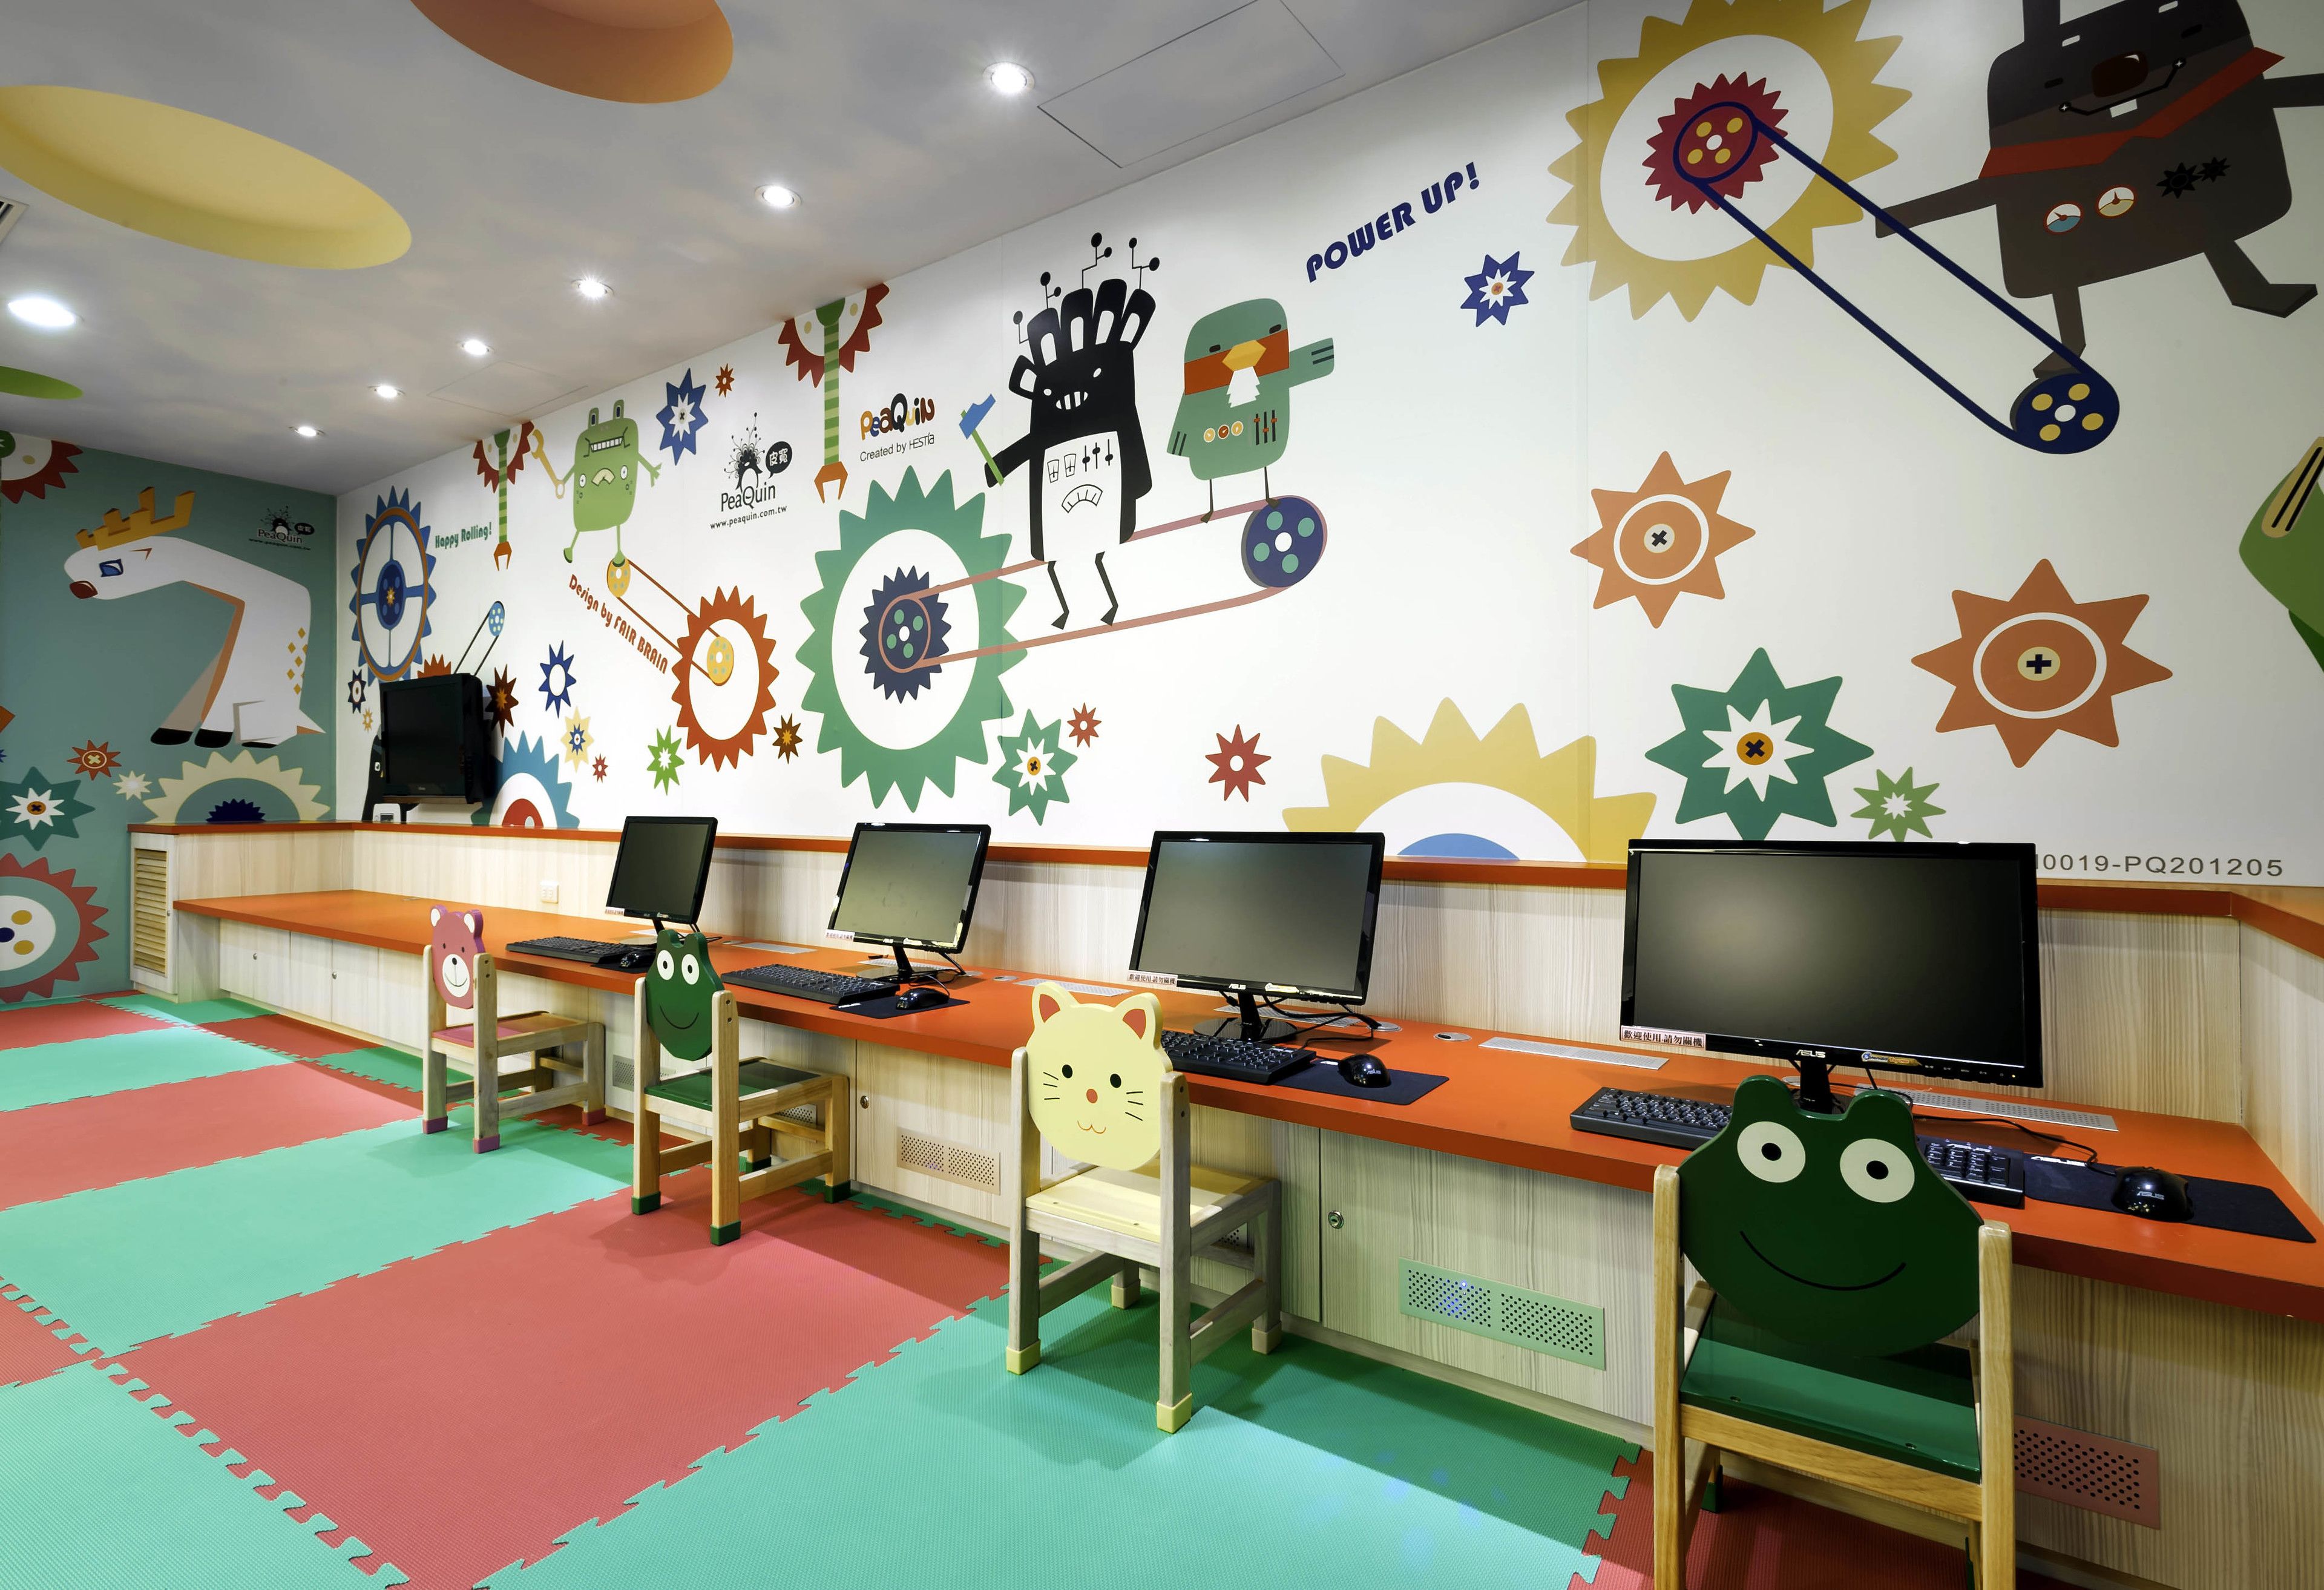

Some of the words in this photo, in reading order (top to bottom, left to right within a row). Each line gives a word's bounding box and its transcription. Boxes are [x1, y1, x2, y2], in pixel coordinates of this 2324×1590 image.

[1306, 202, 1416, 283] POWER
[1420, 161, 1480, 214] UP!
[860, 444, 893, 462] Created
[896, 442, 907, 454] by
[721, 481, 776, 512] PeaQuin
[710, 506, 787, 530] www.peaquin.com.tw
[258, 529, 303, 544] PeaQuin
[435, 533, 459, 549] Happy
[461, 522, 491, 542] Rolling!
[569, 574, 599, 611] Design
[600, 602, 612, 627] by
[614, 616, 637, 646] FAIR
[637, 636, 668, 674] BRAIN
[2036, 853, 2283, 876] 0019-PQ201205
[1796, 1049, 1826, 1059] ASUS
[2030, 1155, 2087, 1168] ASUS
[2137, 1191, 2165, 1200] ASUS
